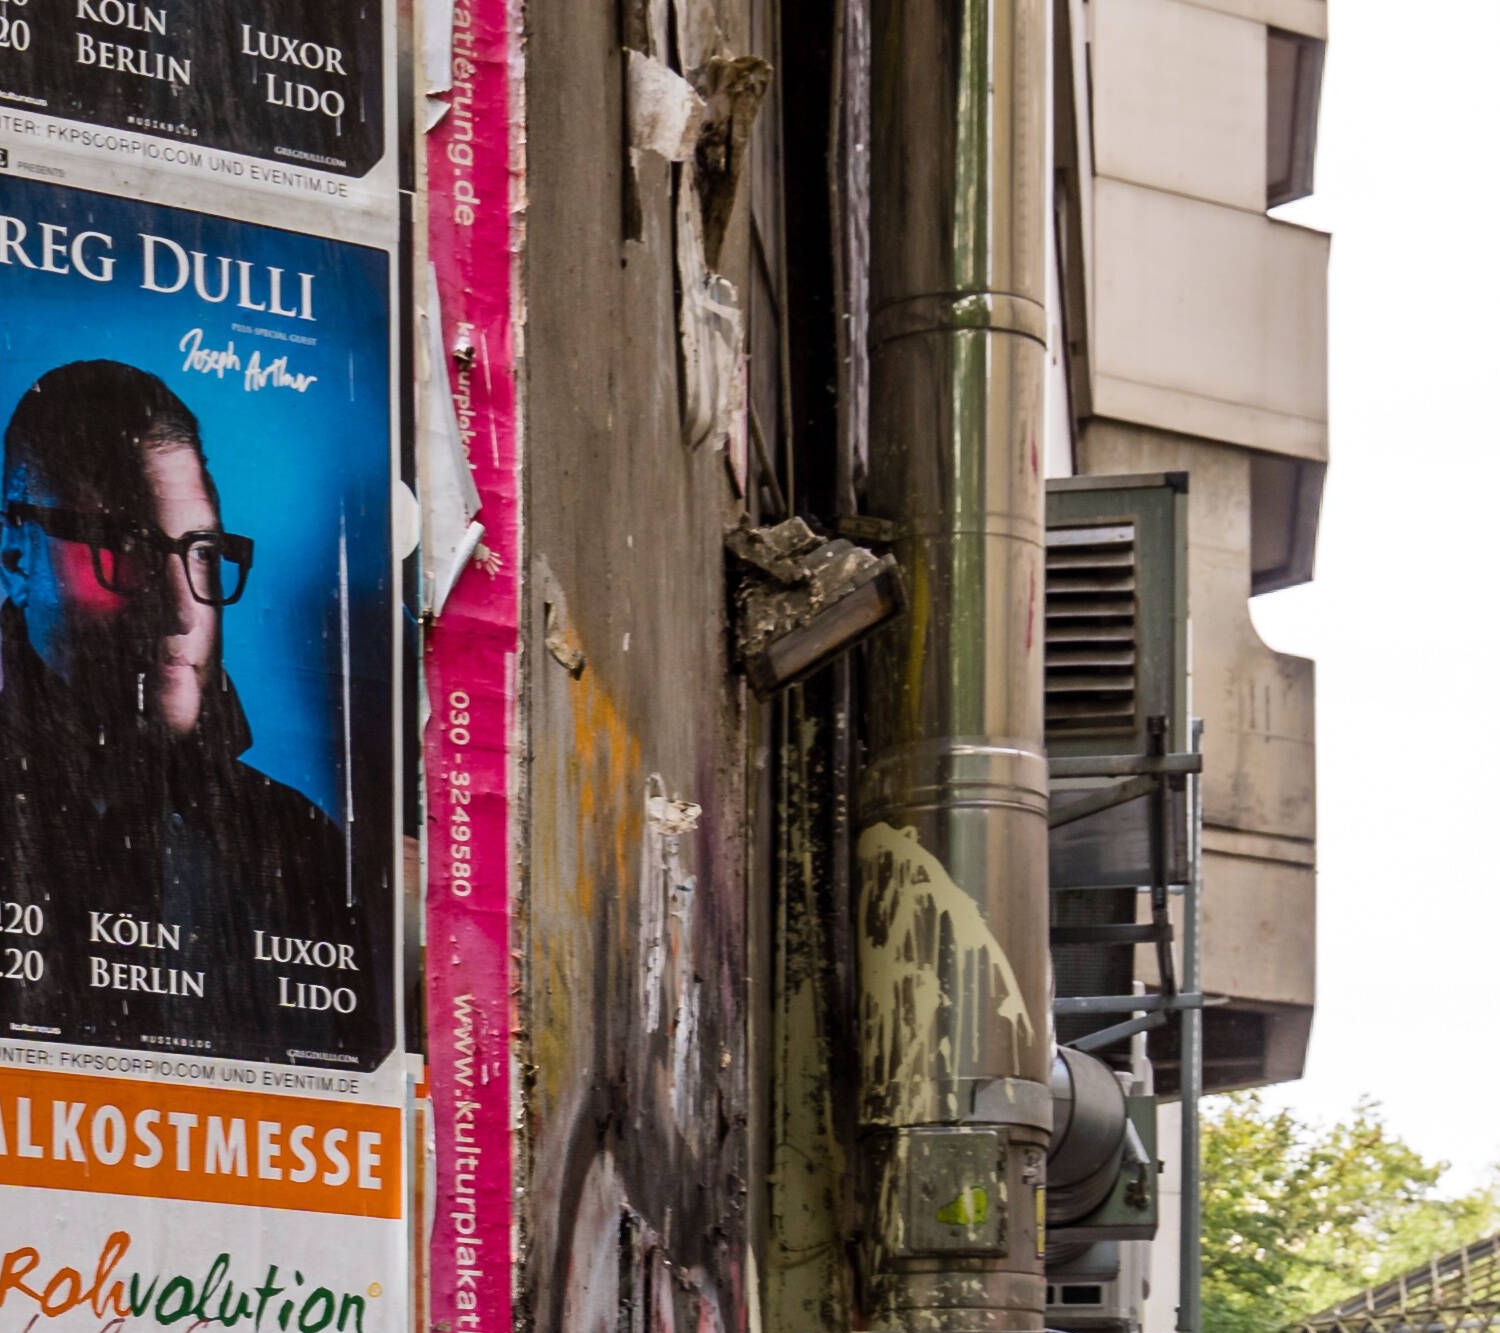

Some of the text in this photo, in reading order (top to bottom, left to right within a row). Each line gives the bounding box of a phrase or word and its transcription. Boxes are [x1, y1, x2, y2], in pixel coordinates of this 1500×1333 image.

[76, 33, 191, 85] BERLIN
[242, 24, 348, 76] LUXOR
[265, 73, 345, 117] LIDO
[47, 124, 203, 168] FKPSCORPIO.COM
[209, 156, 244, 177] UND
[250, 165, 349, 199] EVENTIM.DE
[138, 232, 317, 322] DULLI
[448, 690, 472, 898] 030 3249580
[88, 911, 182, 951] KÖLN
[89, 929, 360, 999] BERLIN LUXOR
[278, 976, 357, 1015] LIDO
[59, 1051, 215, 1081] FKPSCORPIO.COM
[221, 1064, 256, 1085] UND
[261, 1070, 360, 1095] EVENTIM.DE
